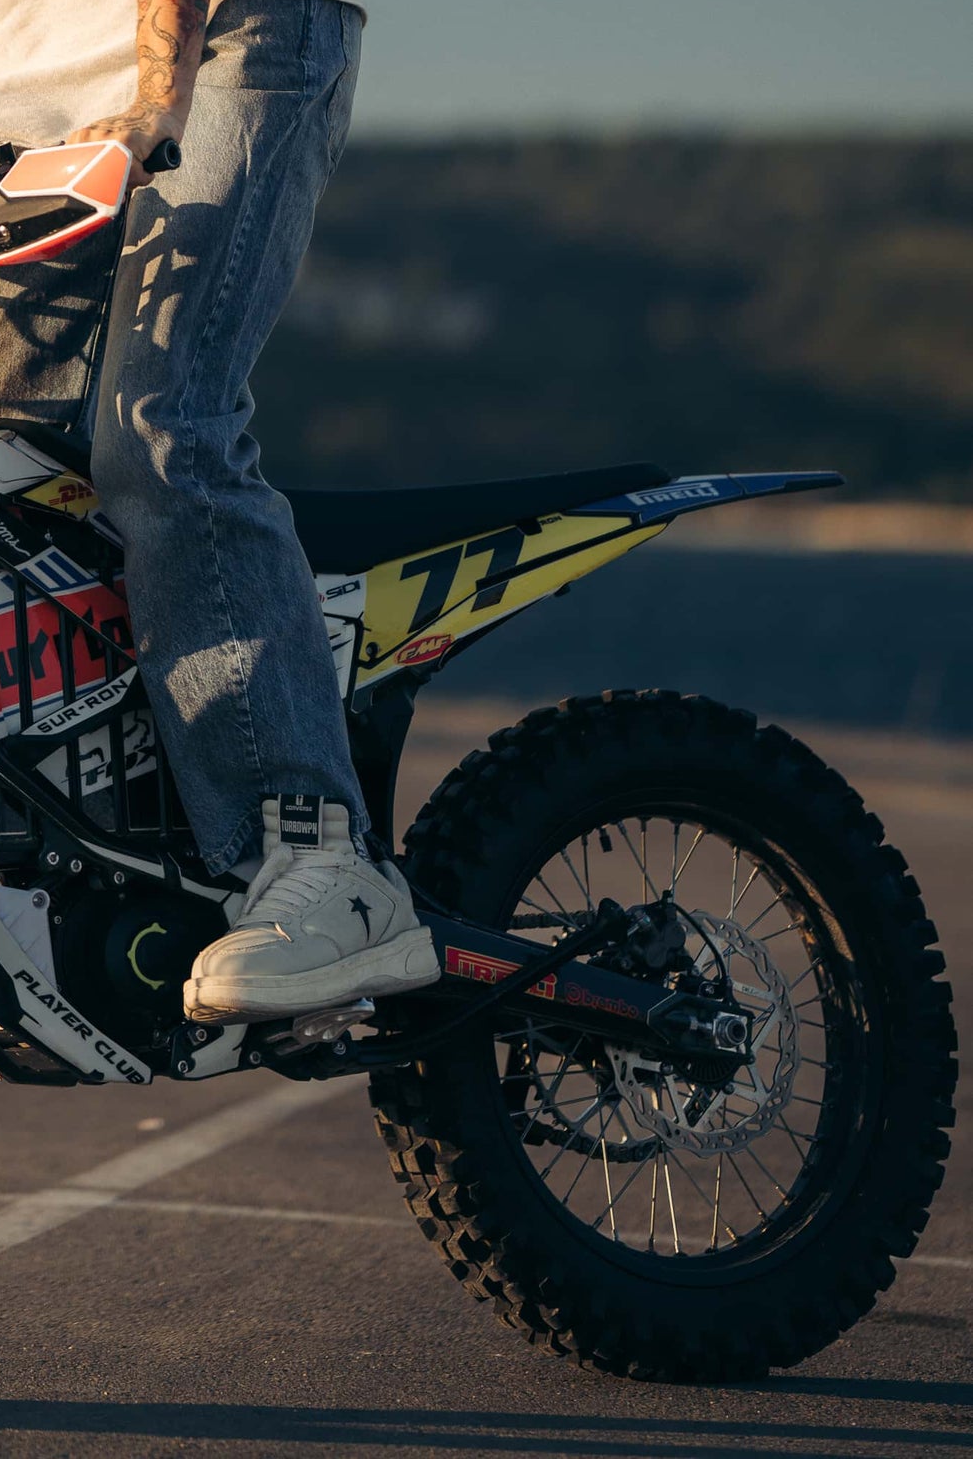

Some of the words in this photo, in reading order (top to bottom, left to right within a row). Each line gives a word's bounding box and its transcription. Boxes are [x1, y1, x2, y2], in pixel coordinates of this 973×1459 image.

[58, 481, 94, 504] DH
[625, 482, 720, 506] PIRELLI
[325, 579, 361, 601] SIDI
[400, 526, 526, 635] 77
[398, 633, 453, 663] FMF
[37, 678, 129, 734] SUR-RON
[445, 945, 557, 1001] PIRLI
[583, 987, 639, 1019] brembo
[13, 969, 94, 1041] PLAYER
[94, 1040, 146, 1085] CLUB
